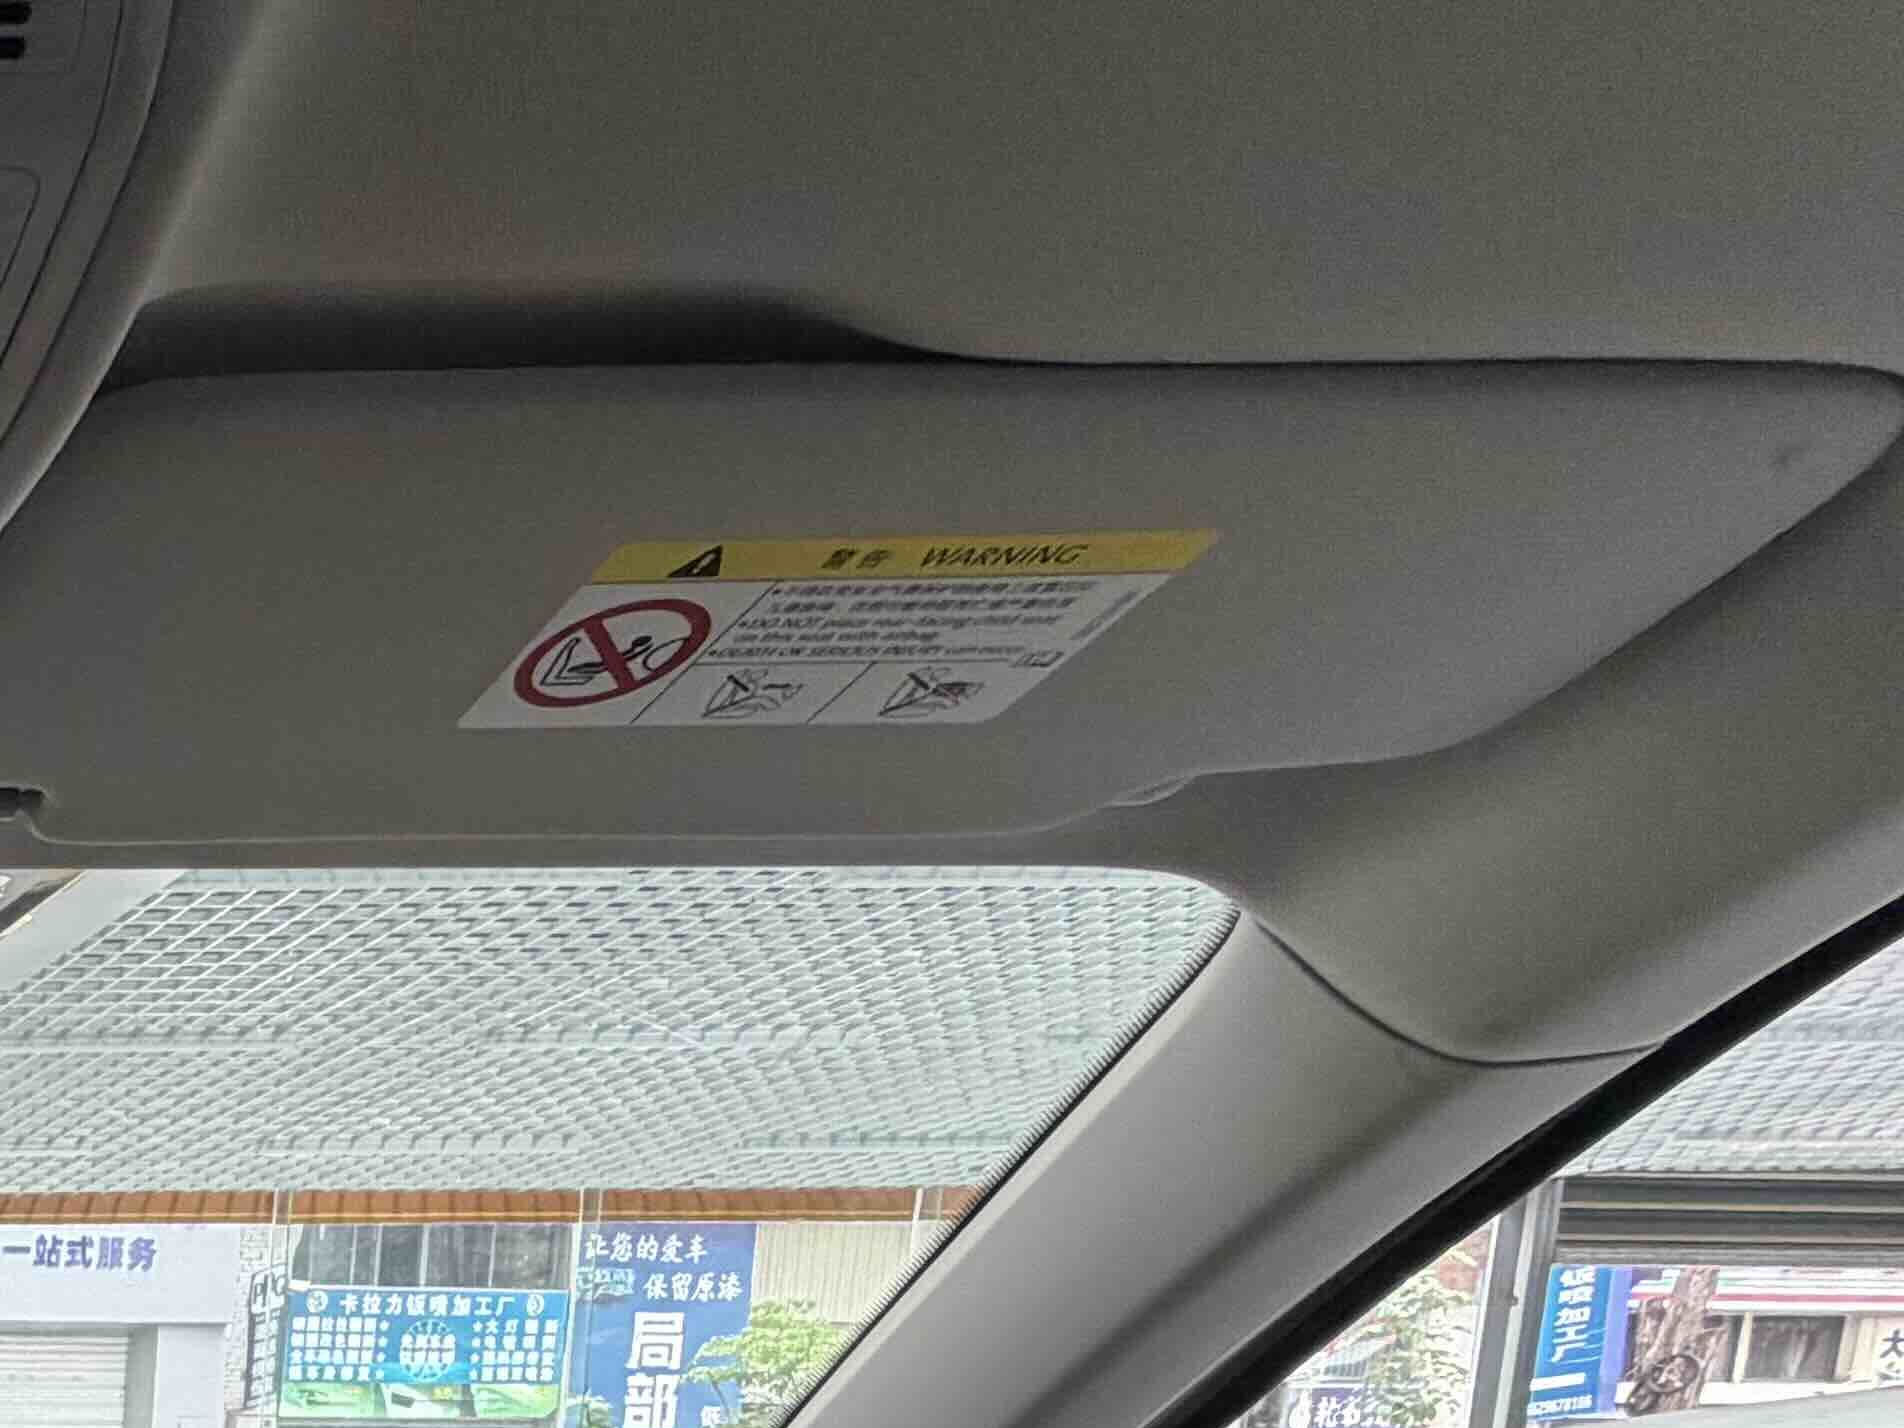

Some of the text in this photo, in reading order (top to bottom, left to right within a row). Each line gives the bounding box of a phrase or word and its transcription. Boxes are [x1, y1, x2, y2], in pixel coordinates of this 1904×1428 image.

[920, 543, 1090, 568] WARNING
[2, 1234, 157, 1272] 一站式服务
[584, 1231, 709, 1263] 让您的爱车
[643, 1271, 744, 1302] 保留原漆
